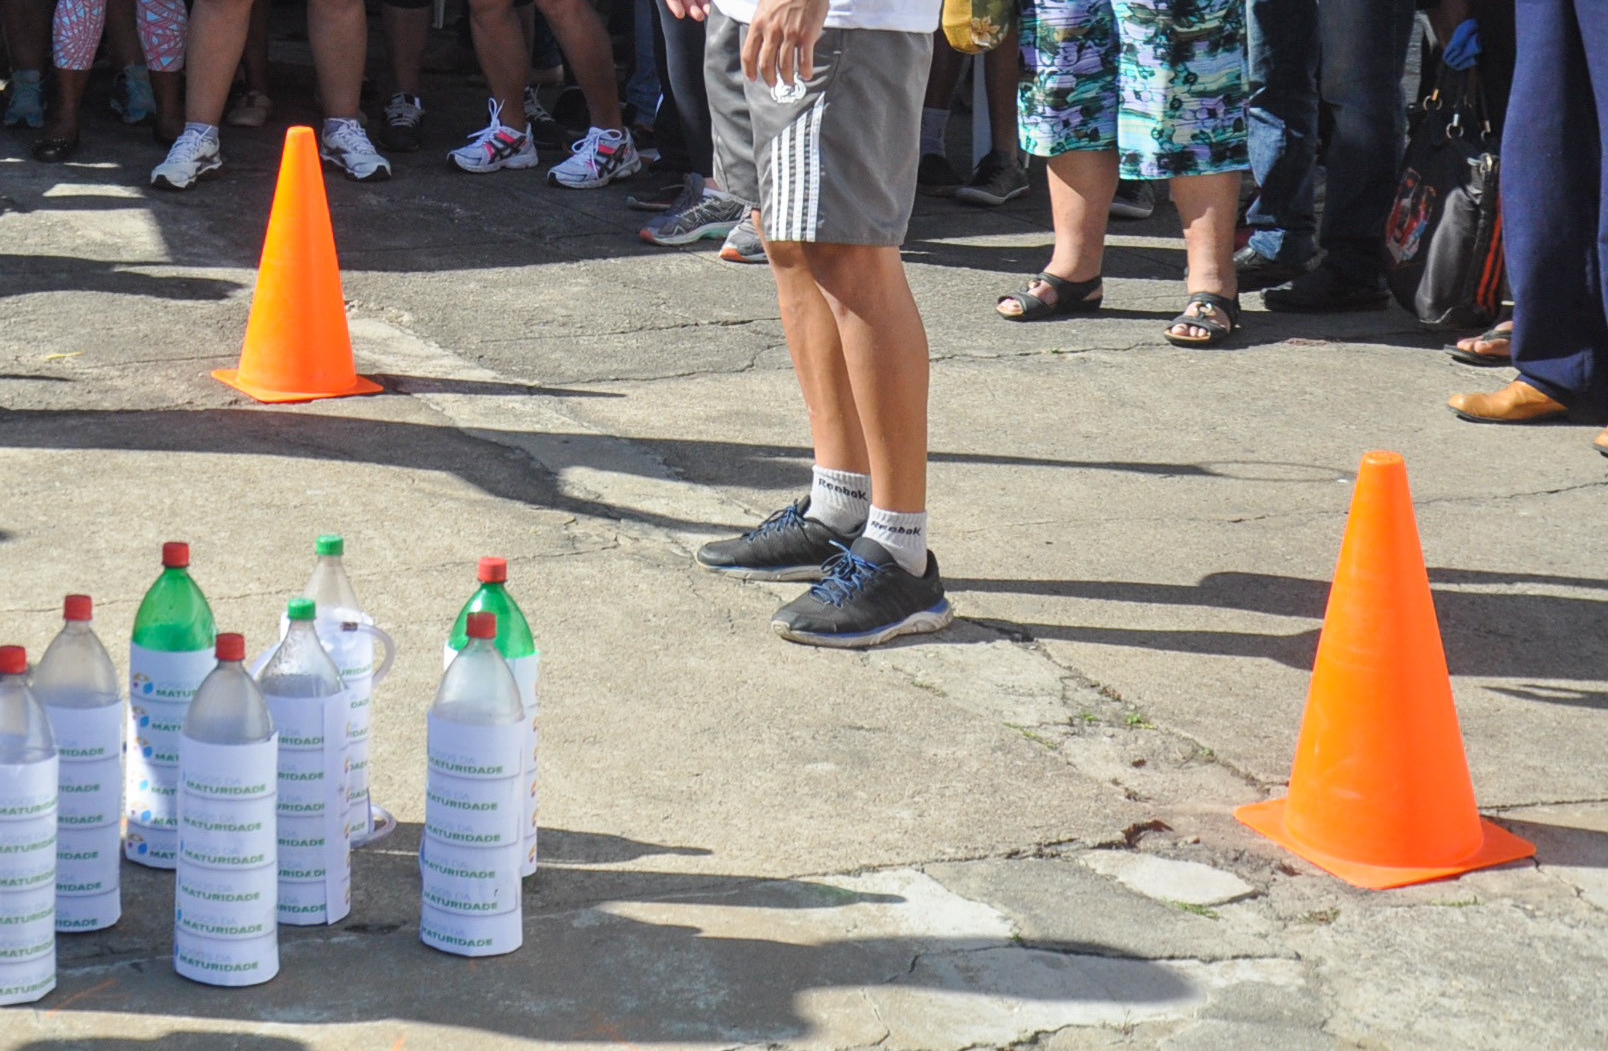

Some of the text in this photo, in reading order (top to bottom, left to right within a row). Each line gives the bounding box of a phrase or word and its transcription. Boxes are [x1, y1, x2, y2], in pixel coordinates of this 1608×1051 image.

[818, 478, 869, 502] Reebok
[186, 779, 267, 795] MATURIDADE
[183, 816, 262, 833] MATURIDADE
[185, 850, 265, 865] MATURIDADE
[181, 885, 261, 903] MATURIDADE
[183, 918, 263, 935] MATURIDADE
[179, 954, 259, 973] MATURIDADE
